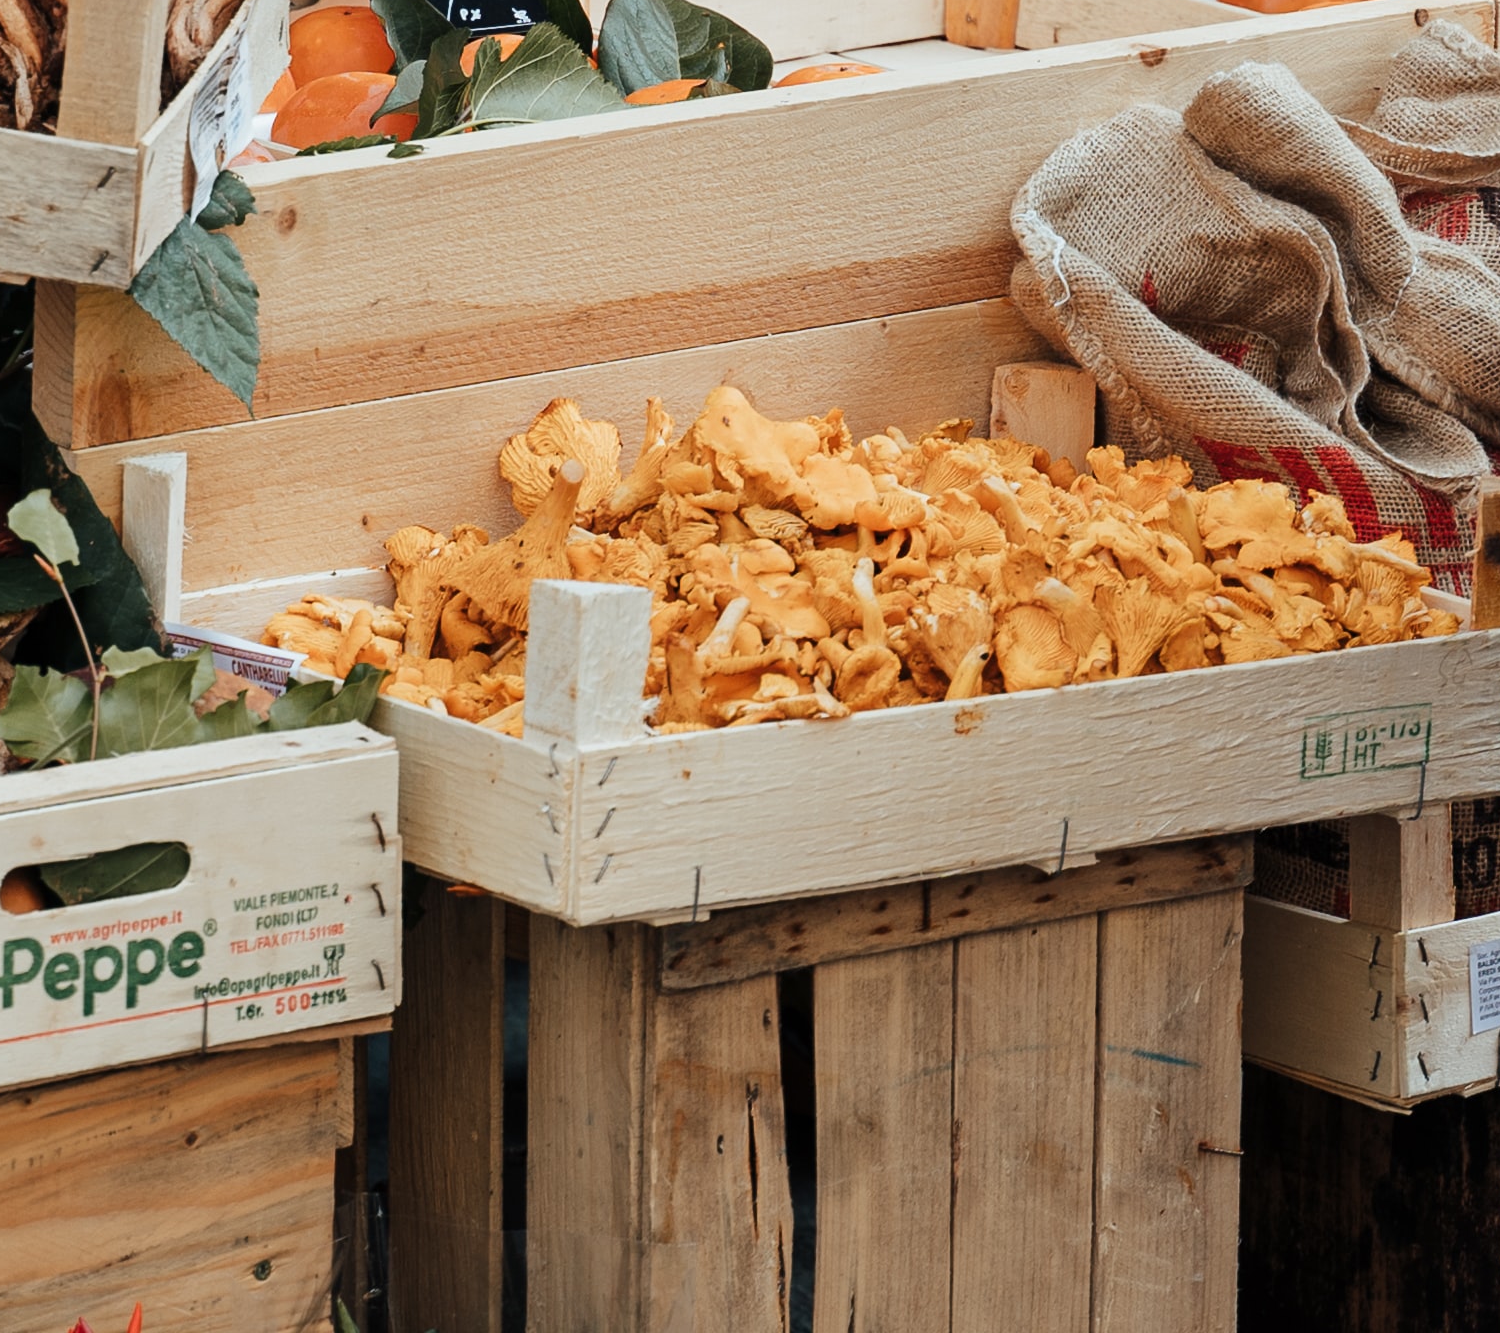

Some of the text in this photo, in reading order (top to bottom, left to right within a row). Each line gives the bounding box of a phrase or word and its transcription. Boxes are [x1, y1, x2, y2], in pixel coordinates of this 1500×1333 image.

[1353, 741, 1383, 768] HT
[233, 894, 268, 913] VIALE
[50, 910, 183, 945] www.agripeppe.it
[255, 909, 294, 930] FONDI
[193, 965, 321, 1000] info@opagripeppe.it
[274, 991, 311, 1017] 500
